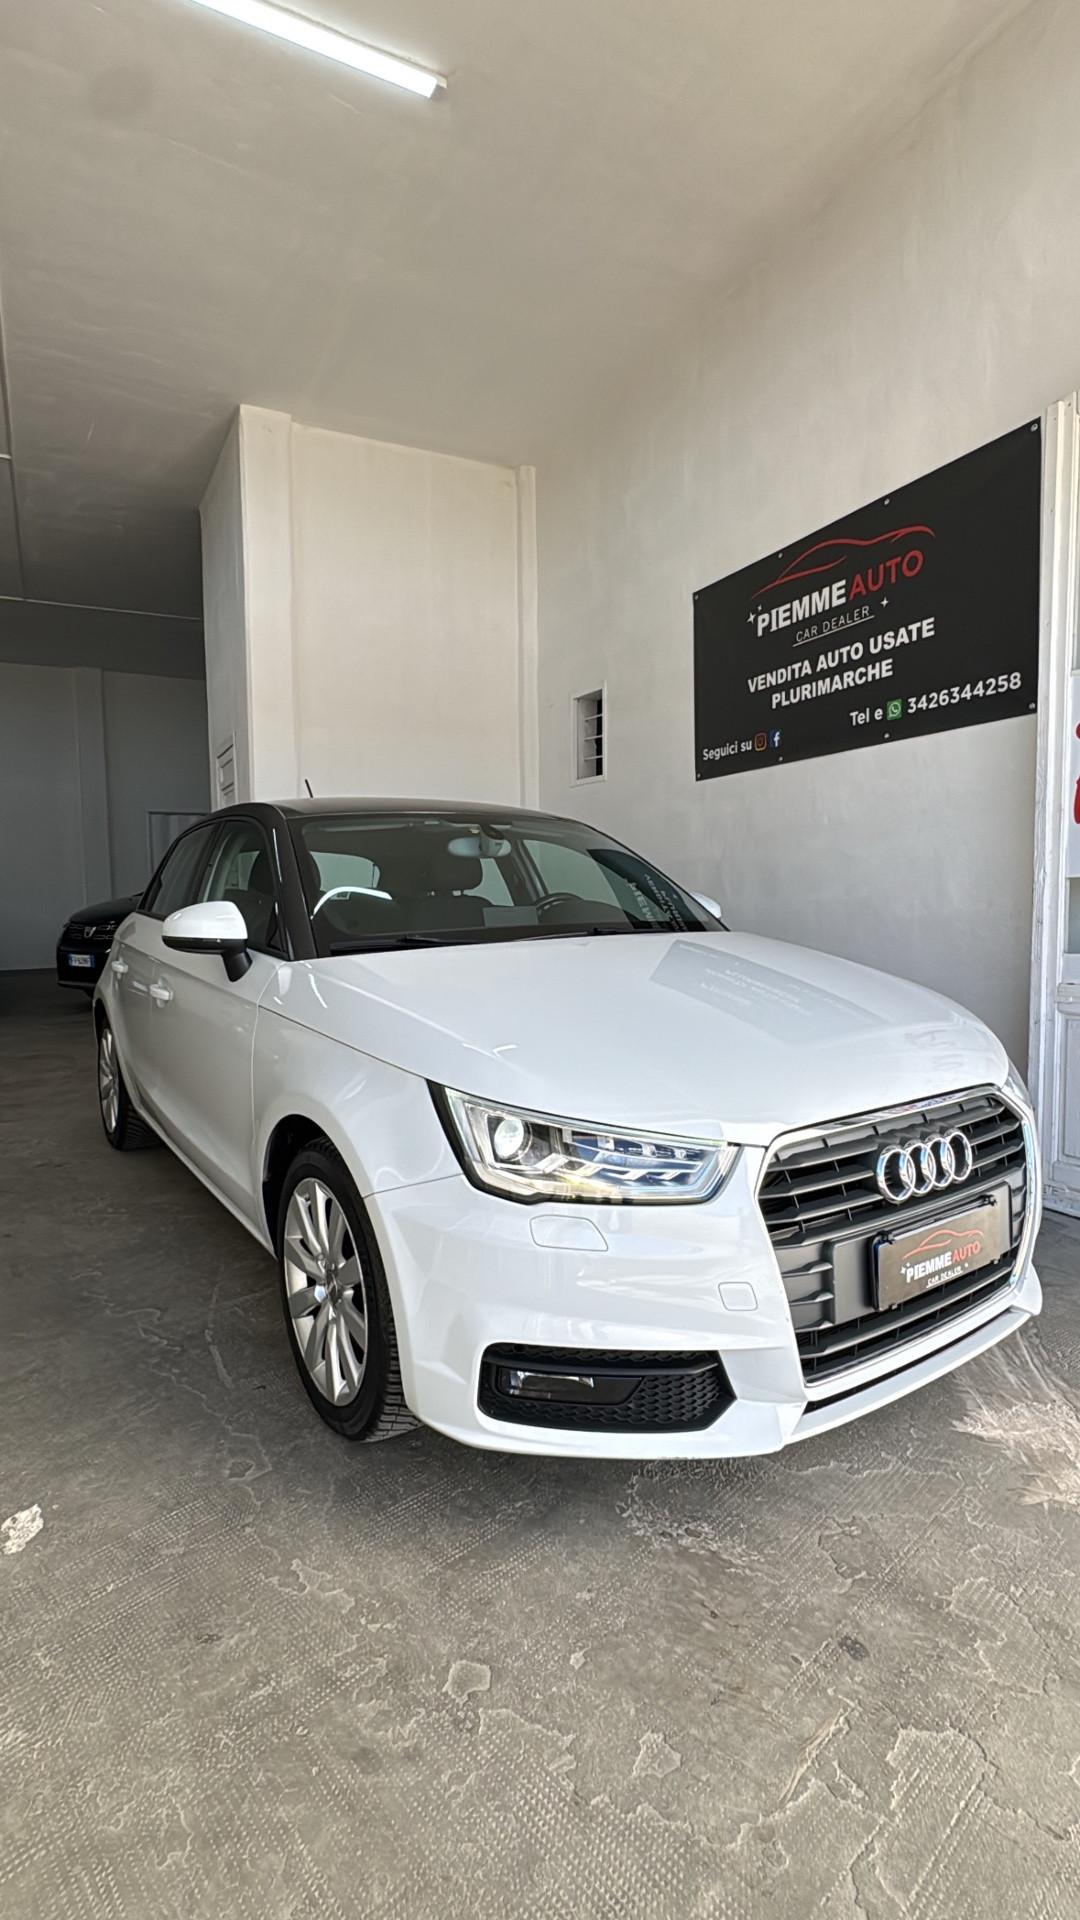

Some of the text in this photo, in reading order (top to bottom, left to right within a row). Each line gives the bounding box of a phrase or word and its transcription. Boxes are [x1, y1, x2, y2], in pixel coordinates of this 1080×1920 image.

[796, 605, 870, 642] CAR DEALER
[747, 617, 935, 693] VENDITA AUTO USATE
[771, 658, 893, 709] PLURIMARCHE
[850, 672, 1021, 726] Tel e 3426344258
[702, 740, 738, 760] Seguici
[740, 740, 752, 752] su
[927, 1275, 939, 1286] CAR
